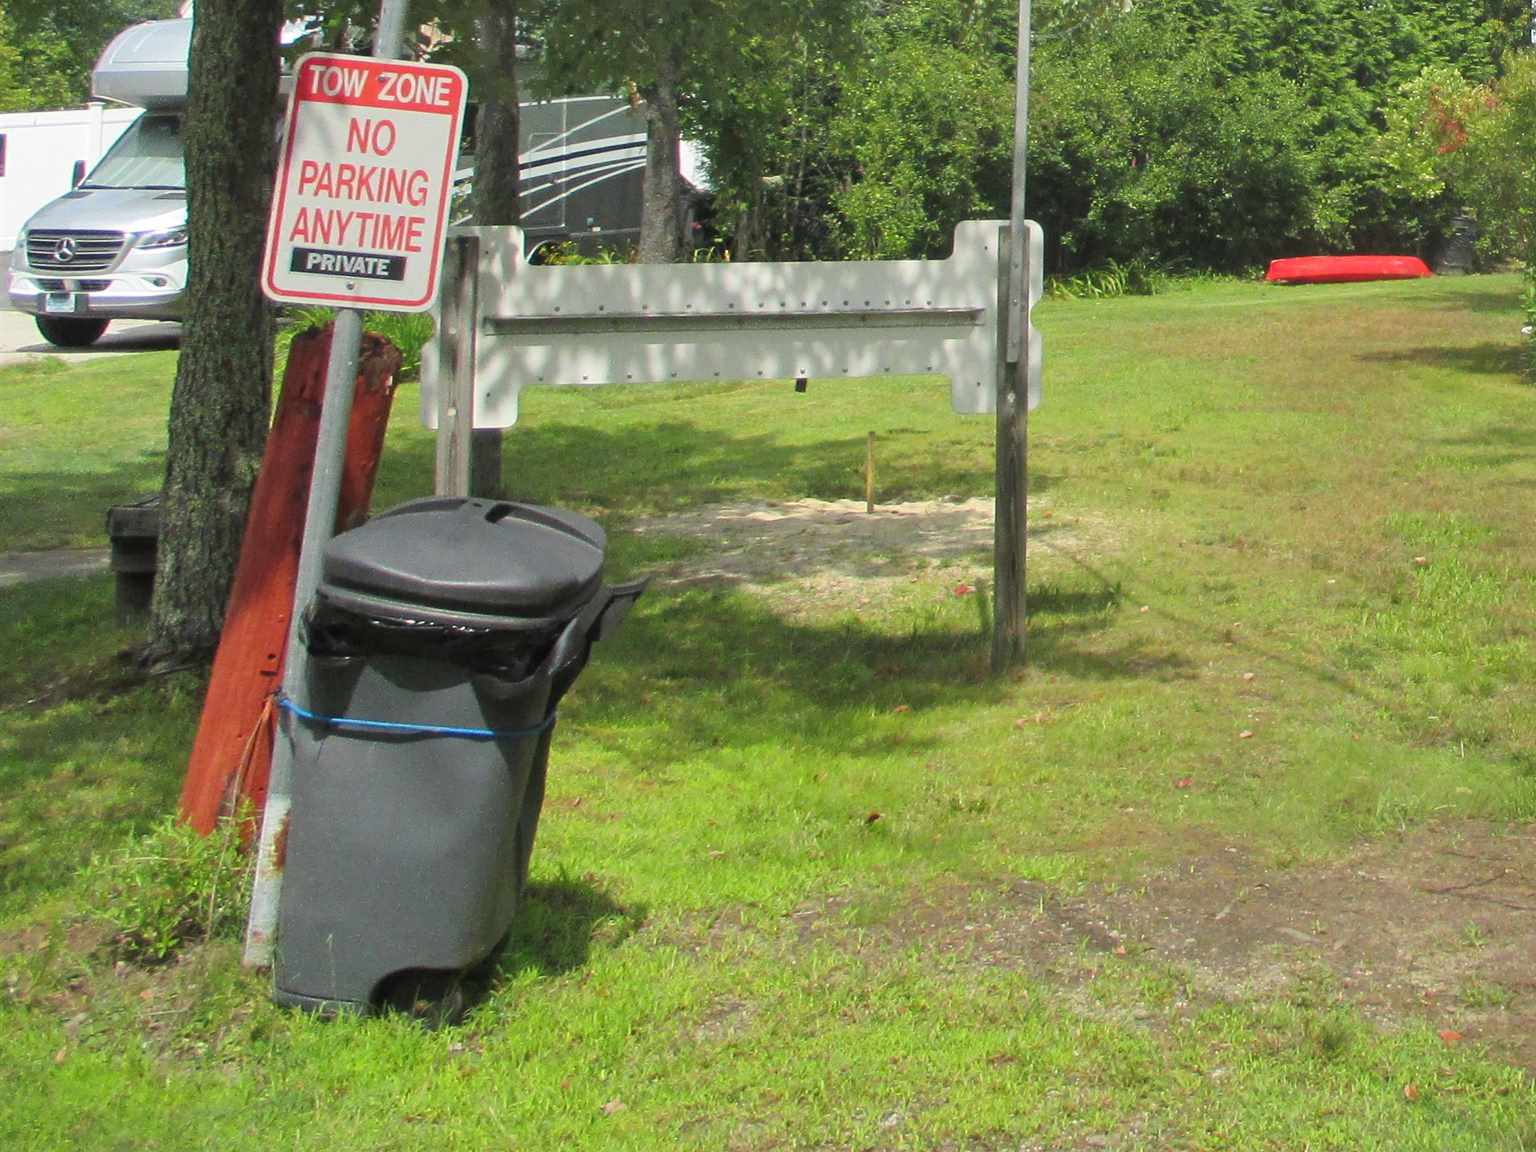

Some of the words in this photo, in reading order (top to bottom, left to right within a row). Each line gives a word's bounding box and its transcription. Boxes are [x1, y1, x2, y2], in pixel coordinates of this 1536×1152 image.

[309, 64, 368, 98] TOW
[377, 71, 453, 106] ZONE
[346, 117, 396, 156] NO
[298, 159, 429, 207] PARKING
[289, 206, 425, 252] ANYTIME
[306, 252, 390, 276] PRIVATE
